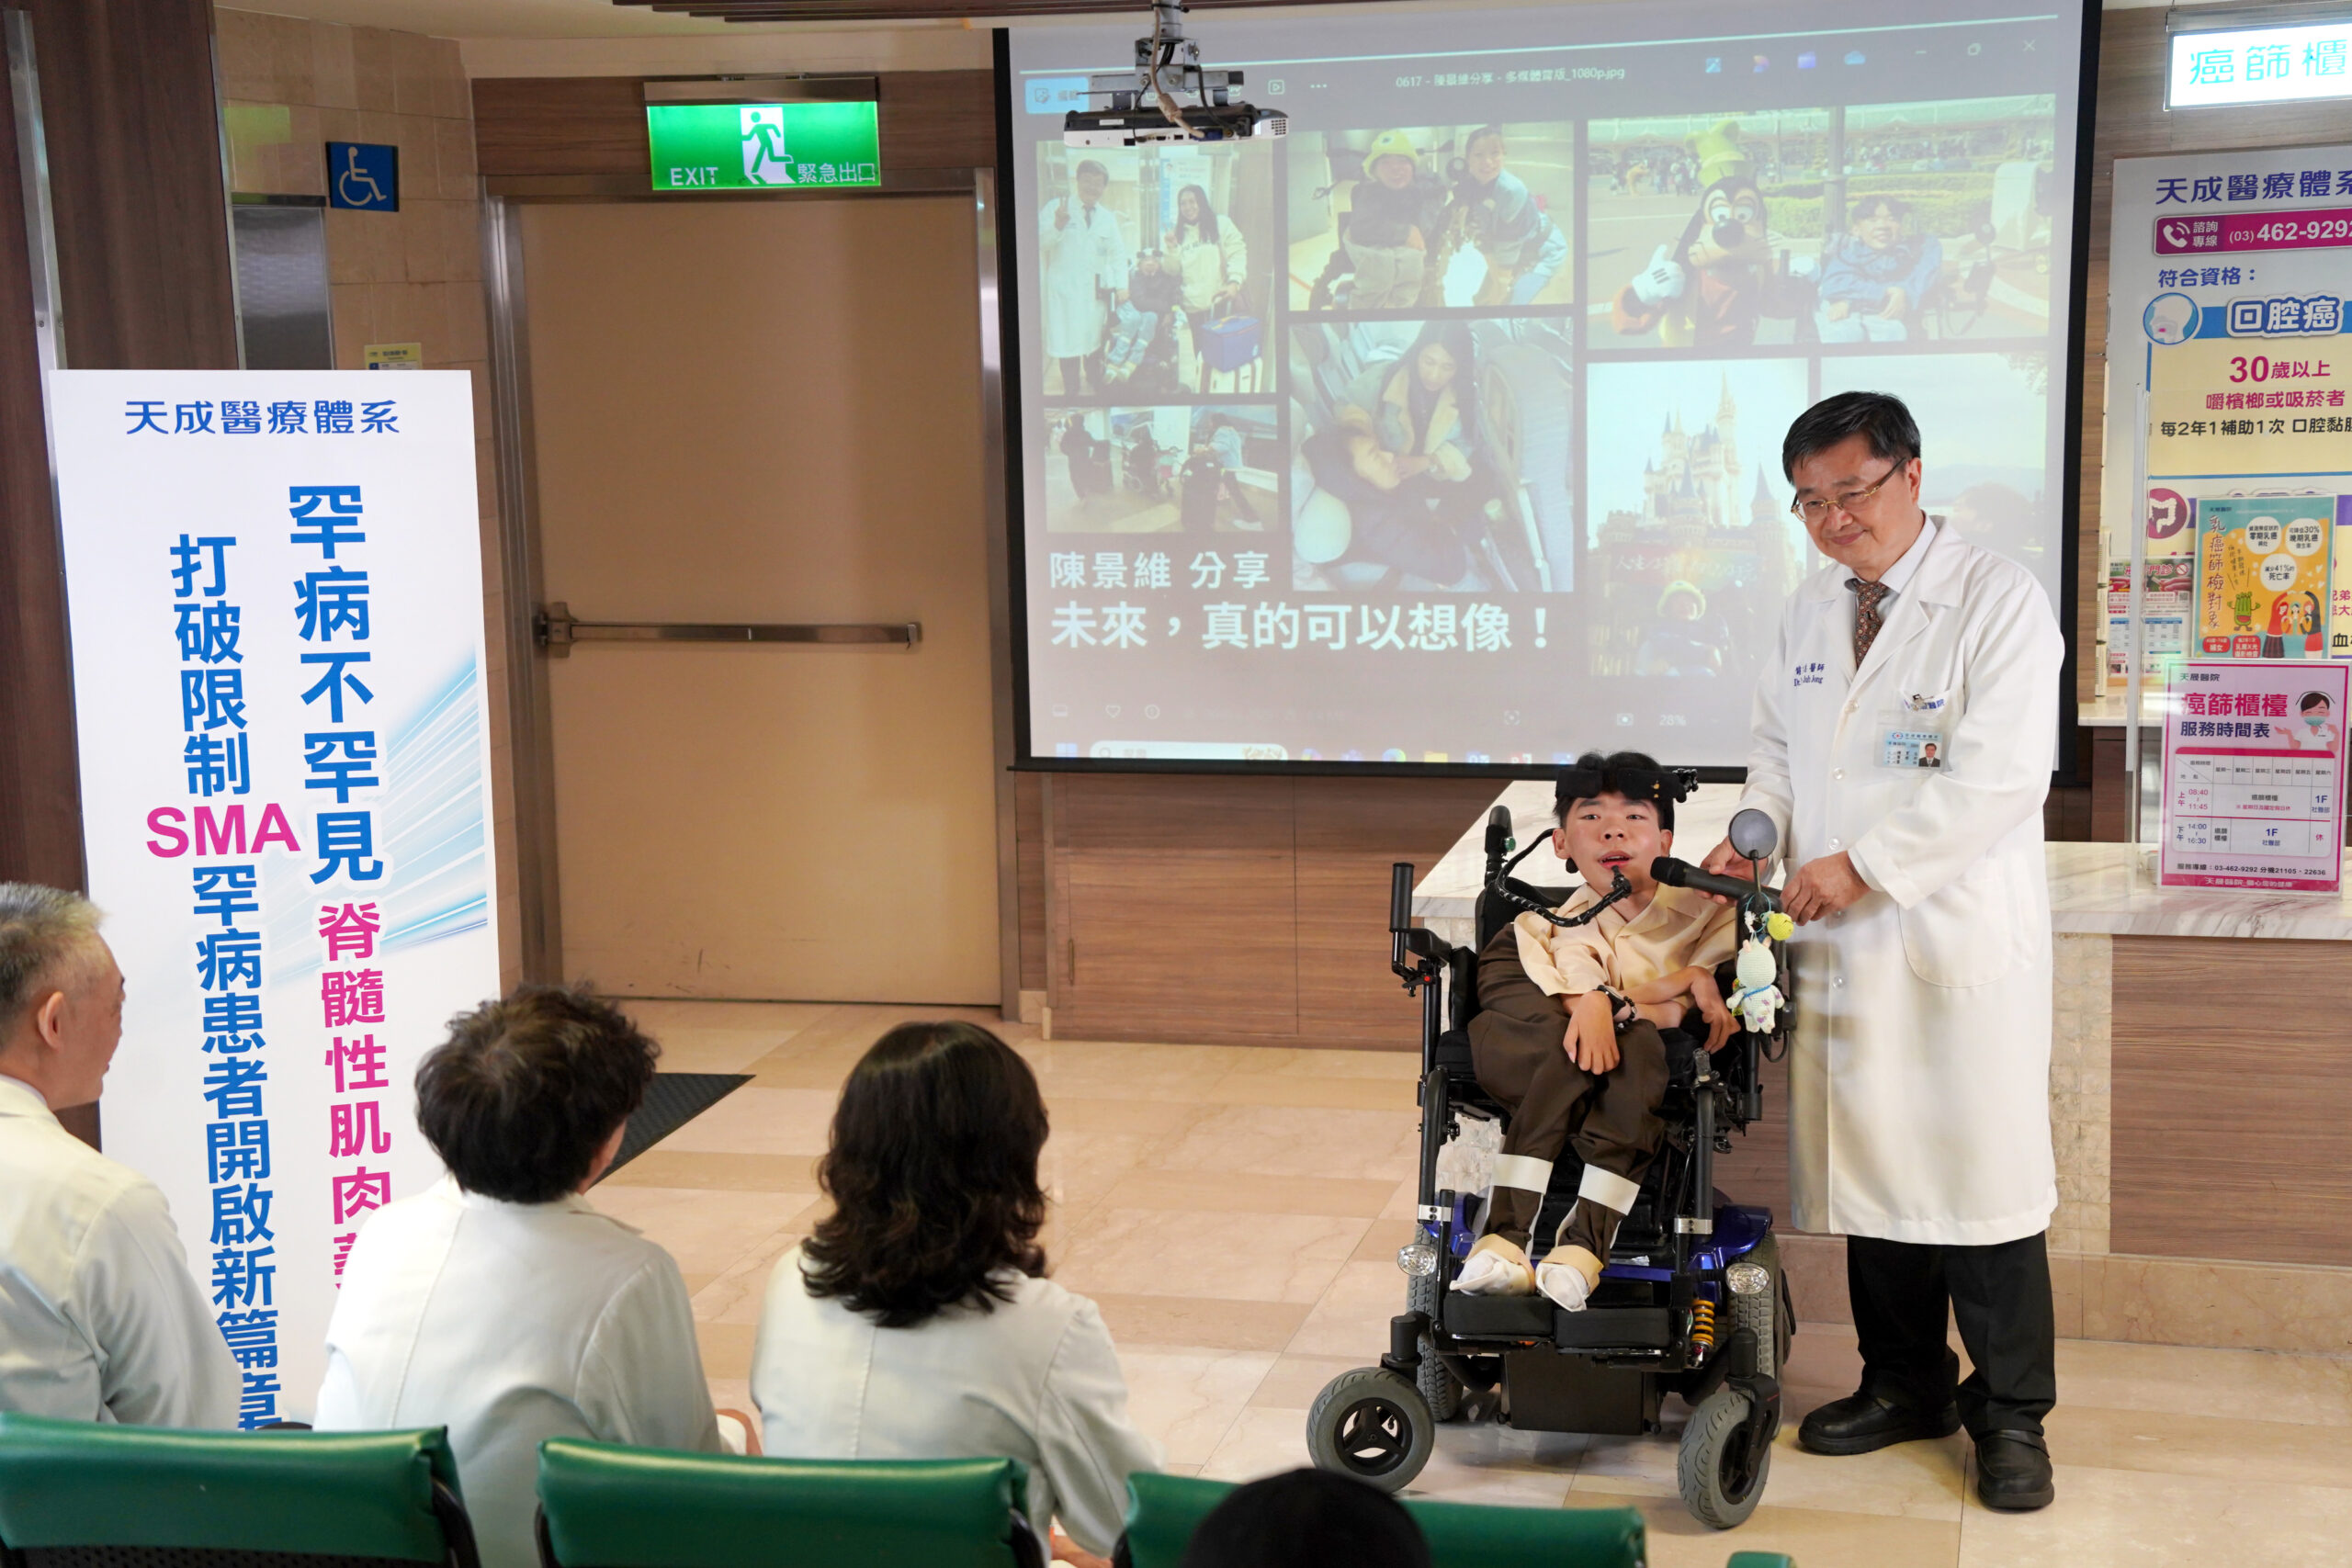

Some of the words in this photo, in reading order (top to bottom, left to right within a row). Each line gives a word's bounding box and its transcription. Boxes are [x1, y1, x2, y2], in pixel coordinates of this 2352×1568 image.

[2189, 39, 2347, 85] 癌篩櫃
[1396, 75, 1422, 88] 0617
[670, 167, 718, 186] EXIT
[797, 162, 876, 184] 緊急出口
[2155, 169, 2352, 205] 天成醫療體系
[2192, 221, 2218, 233] 諮詢
[2256, 220, 2352, 243] 462-929
[2192, 235, 2218, 247] 專線
[2158, 265, 2256, 288] 符合資格：
[2233, 297, 2339, 333] 口腔癌
[2229, 355, 2331, 383] 30歲以上
[2206, 389, 2346, 410] 嚼檳榔或吸菸者
[125, 400, 400, 434] 天成醫療體系
[1049, 551, 1172, 590] 陳景維
[1189, 550, 1271, 589] 分享
[2146, 564, 2173, 576] 門診
[1051, 601, 1548, 651] 未來，真的可以想像！
[170, 534, 251, 797] 打破限制
[288, 485, 383, 885] 罕病不罕見
[1659, 714, 1687, 727] 28%
[2180, 721, 2270, 739] 服務時間表
[2315, 795, 2328, 804] 1F
[146, 803, 301, 858] SMA
[2266, 828, 2278, 837] 1F
[318, 901, 391, 1289] 脊髓性肌肉
